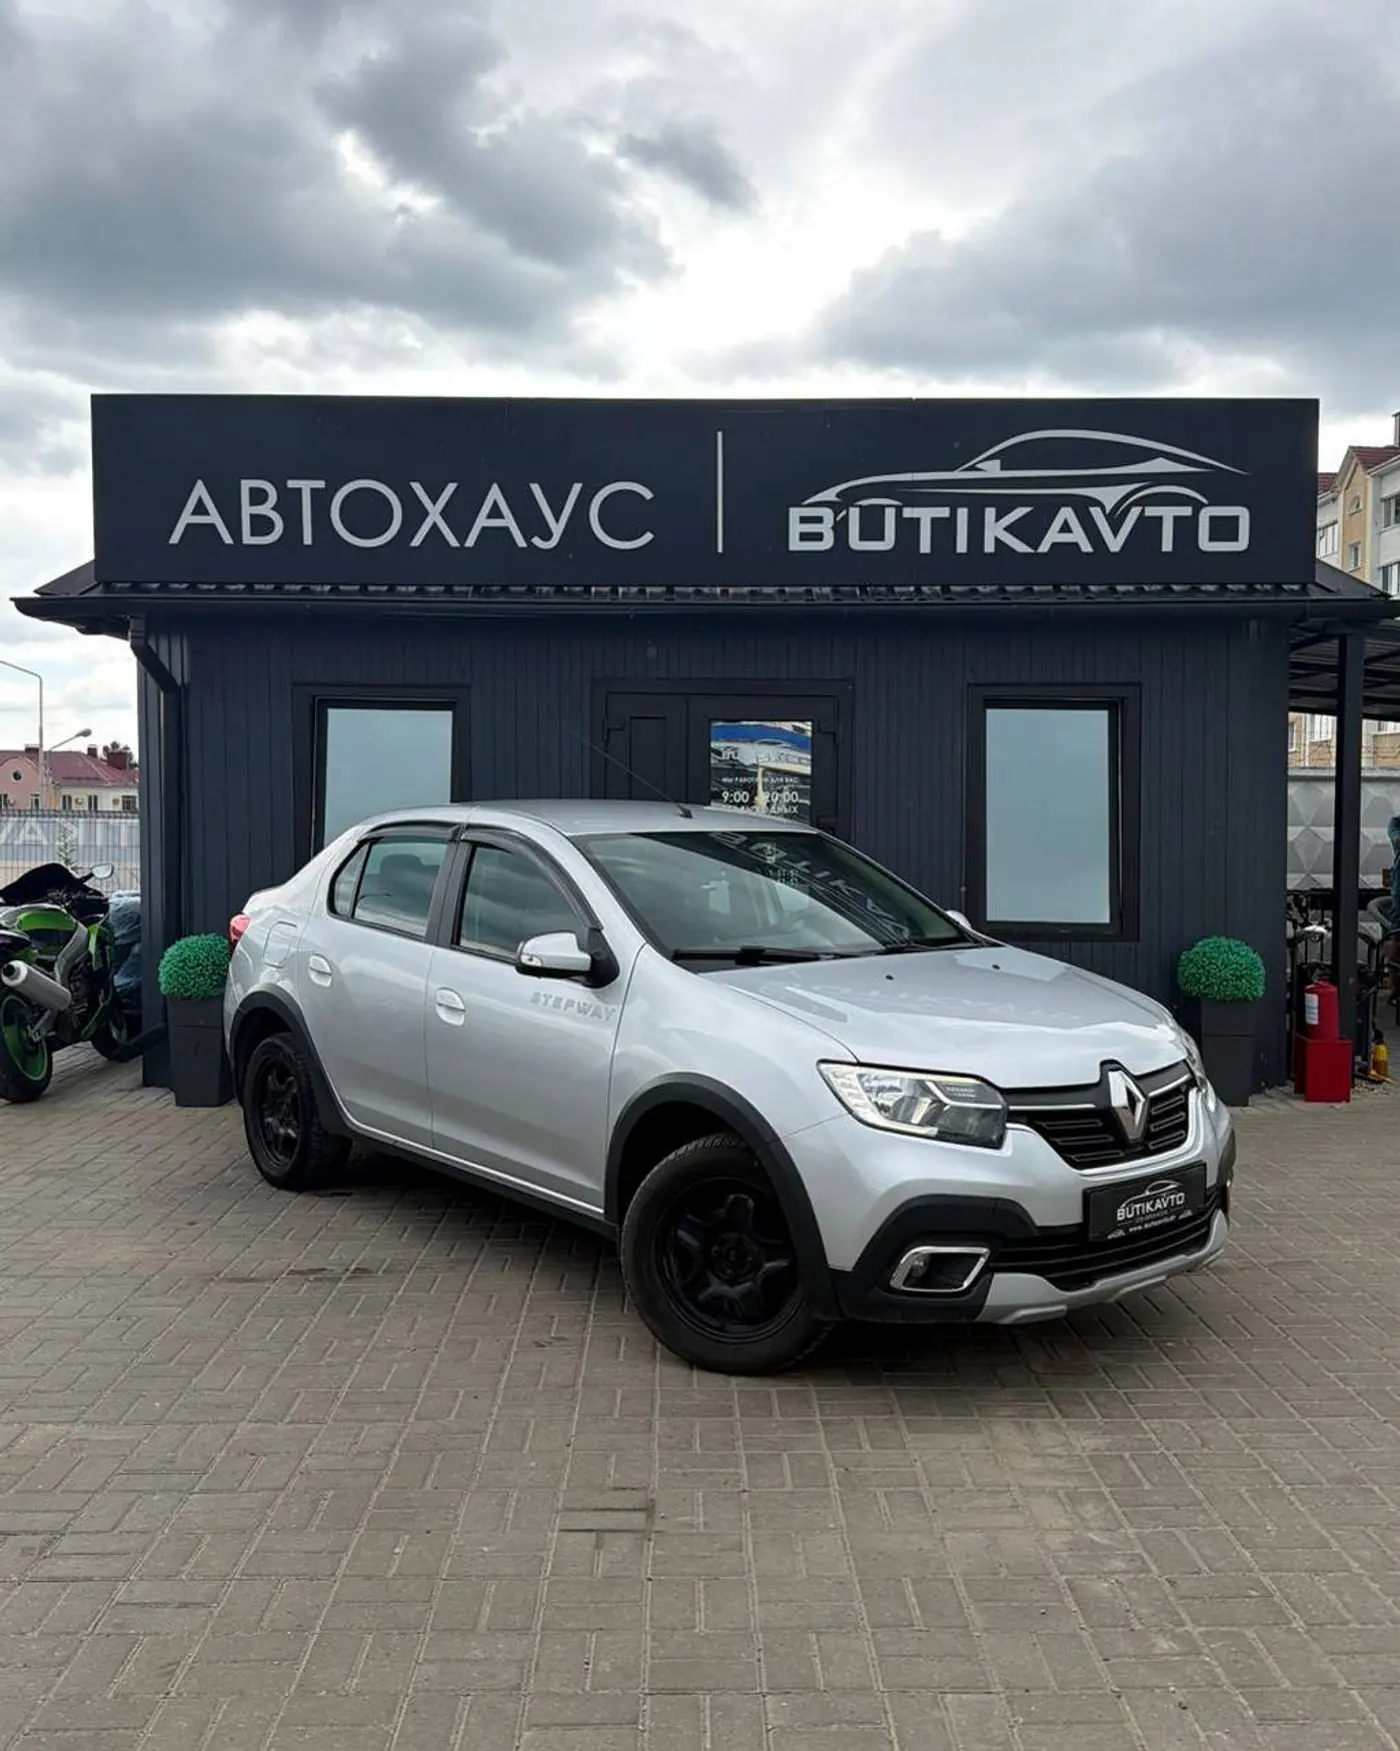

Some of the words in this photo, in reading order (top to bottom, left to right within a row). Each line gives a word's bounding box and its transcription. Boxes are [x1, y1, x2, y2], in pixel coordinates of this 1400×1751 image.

[168, 478, 654, 550] АВТОХАУС
[788, 506, 1251, 554] BUTIKAVTO
[721, 791, 750, 804] 9:00
[529, 991, 617, 1022] STEPWAY
[1116, 1192, 1186, 1221] BUTIKAVTO
